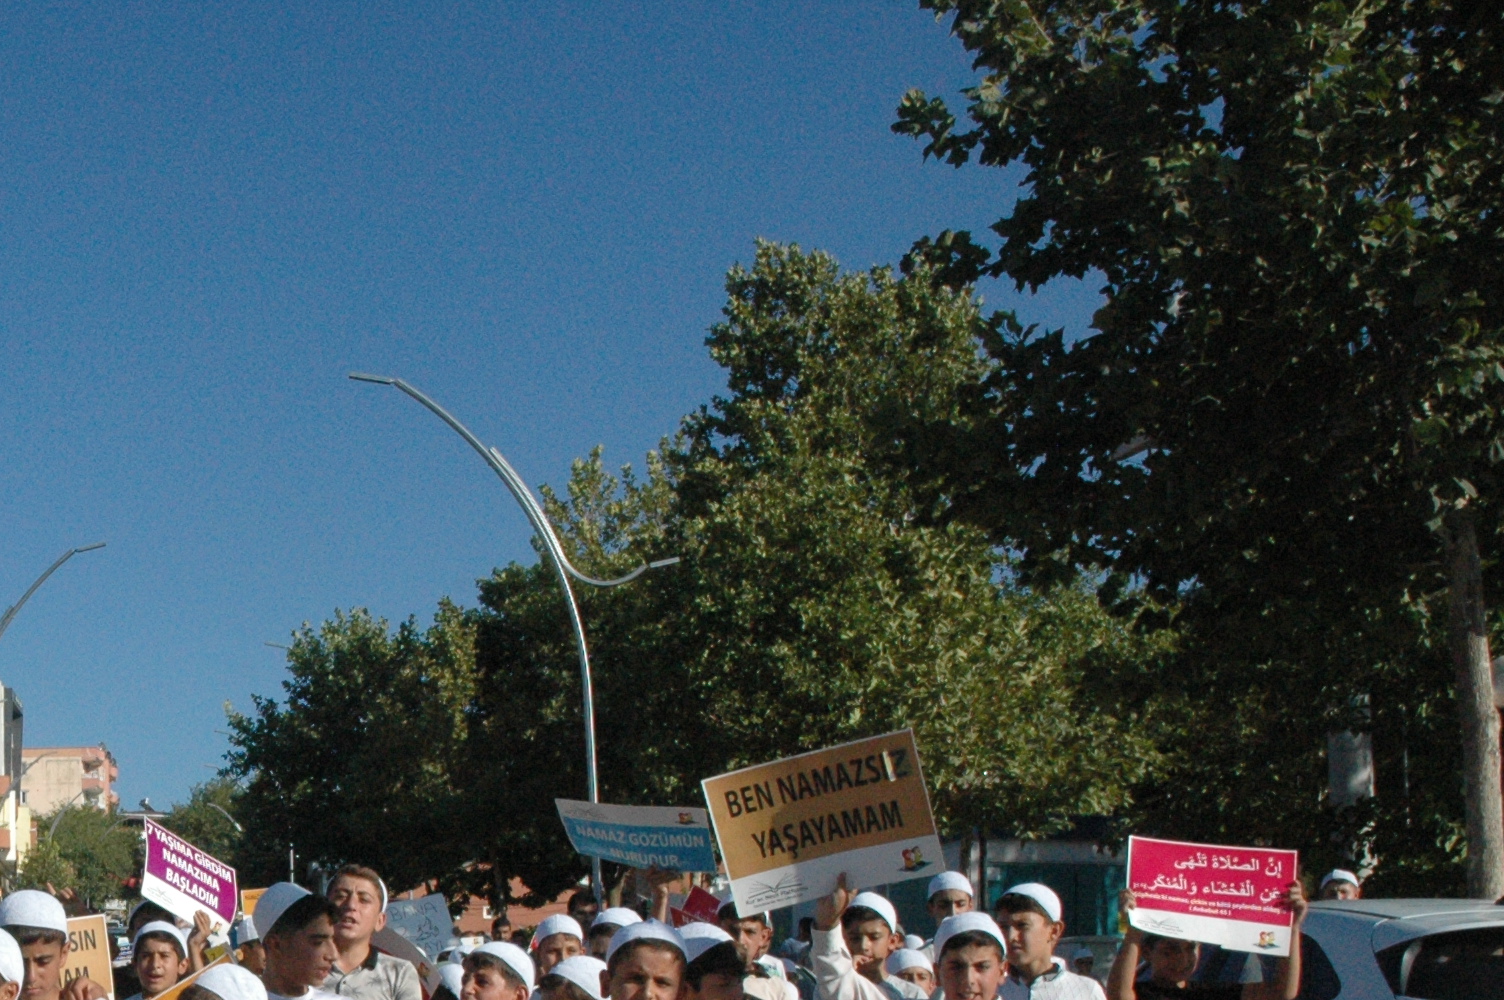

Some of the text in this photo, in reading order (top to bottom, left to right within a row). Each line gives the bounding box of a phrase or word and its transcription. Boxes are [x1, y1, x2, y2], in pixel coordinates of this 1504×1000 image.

[724, 781, 774, 818] BEN
[577, 825, 626, 843] NAMAZ
[751, 800, 904, 859] YAŞAYAMAM
[147, 823, 232, 883] 7 YAŞIMA GİRDİM
[162, 848, 220, 892] NAMAZIMA
[165, 868, 219, 909] BAŞLADIM
[69, 928, 96, 952] SIN
